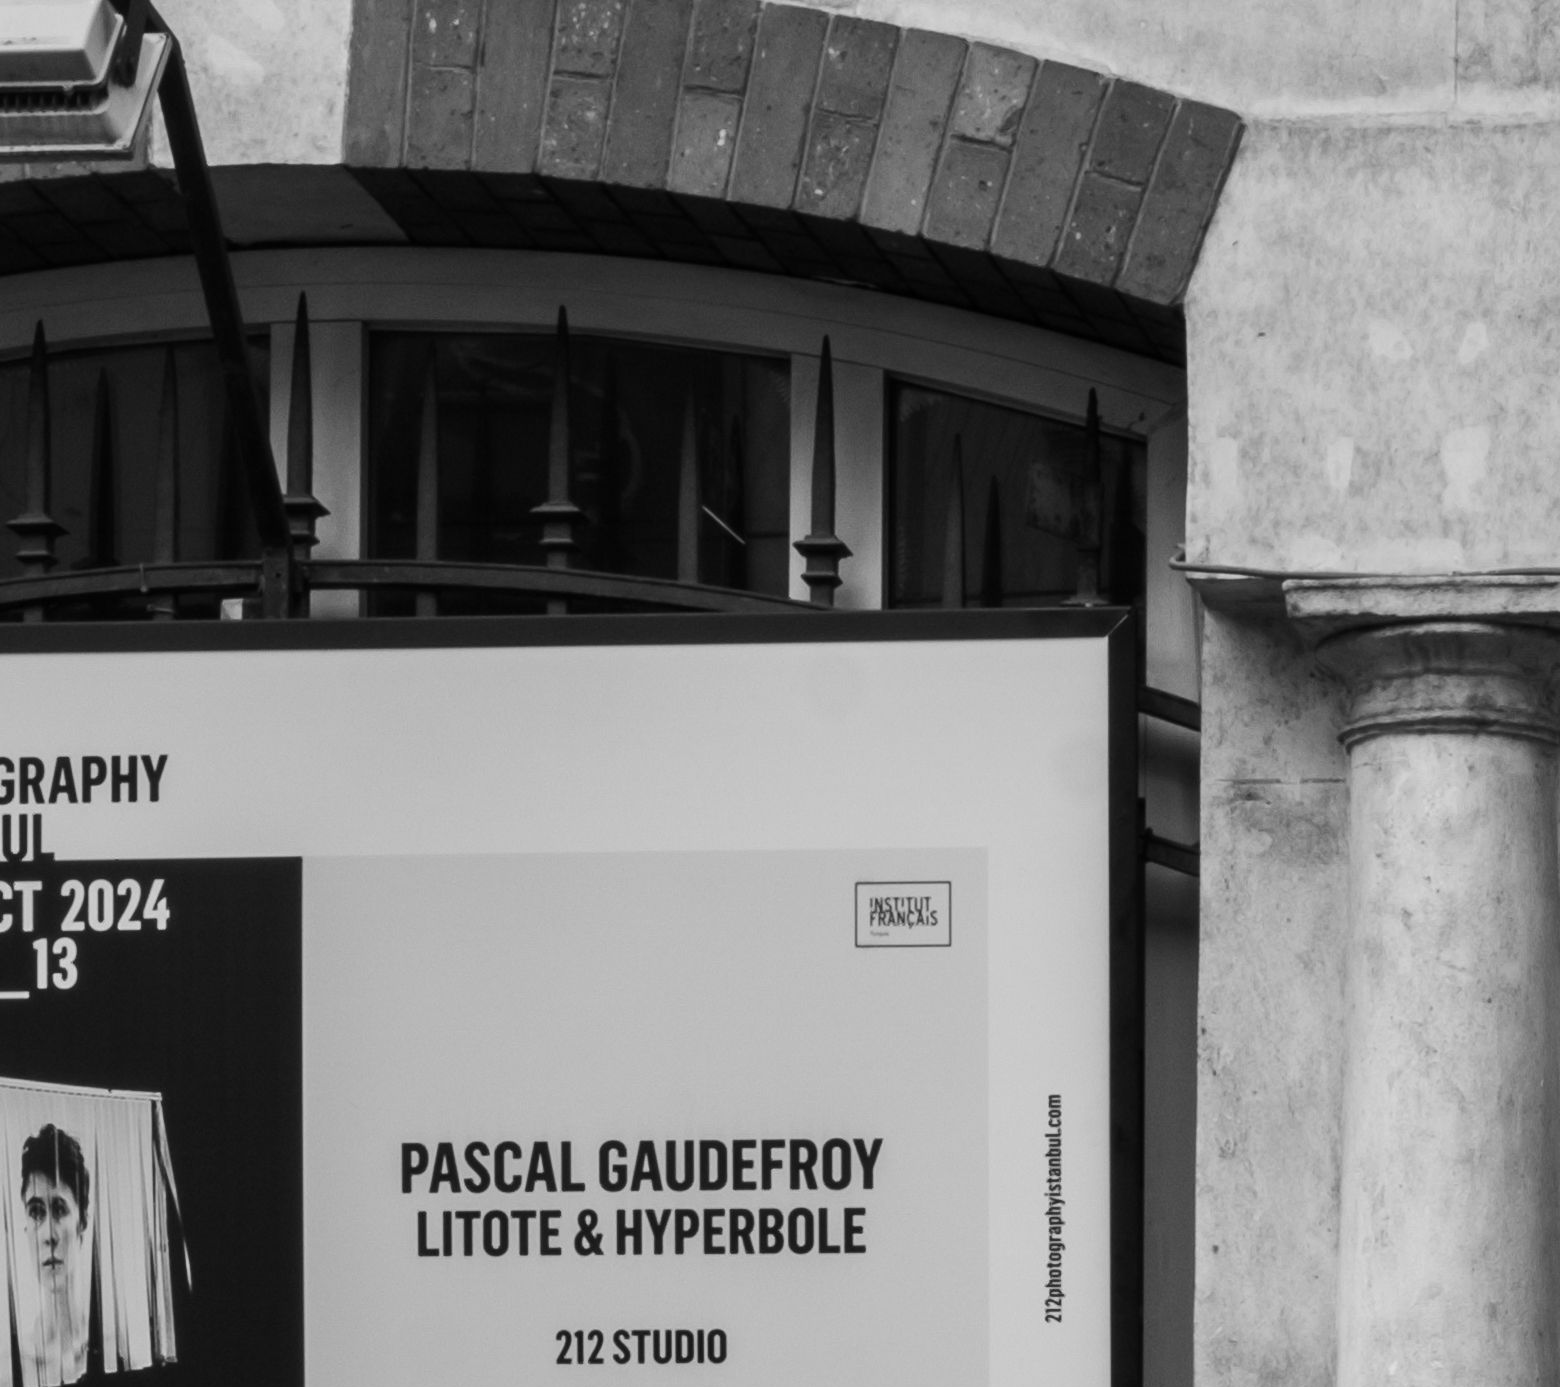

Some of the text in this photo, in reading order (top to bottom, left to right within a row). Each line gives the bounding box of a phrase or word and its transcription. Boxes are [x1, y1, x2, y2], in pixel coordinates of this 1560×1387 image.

[60, 879, 171, 932] 2024
[402, 1138, 882, 1193] PASCAL GAUDEFROY
[418, 1208, 866, 1256] LITOTE & HYPERBOLE
[1045, 1095, 1065, 1322] 212photographyistanbul.com
[556, 1329, 726, 1364] 212 STUDIO
